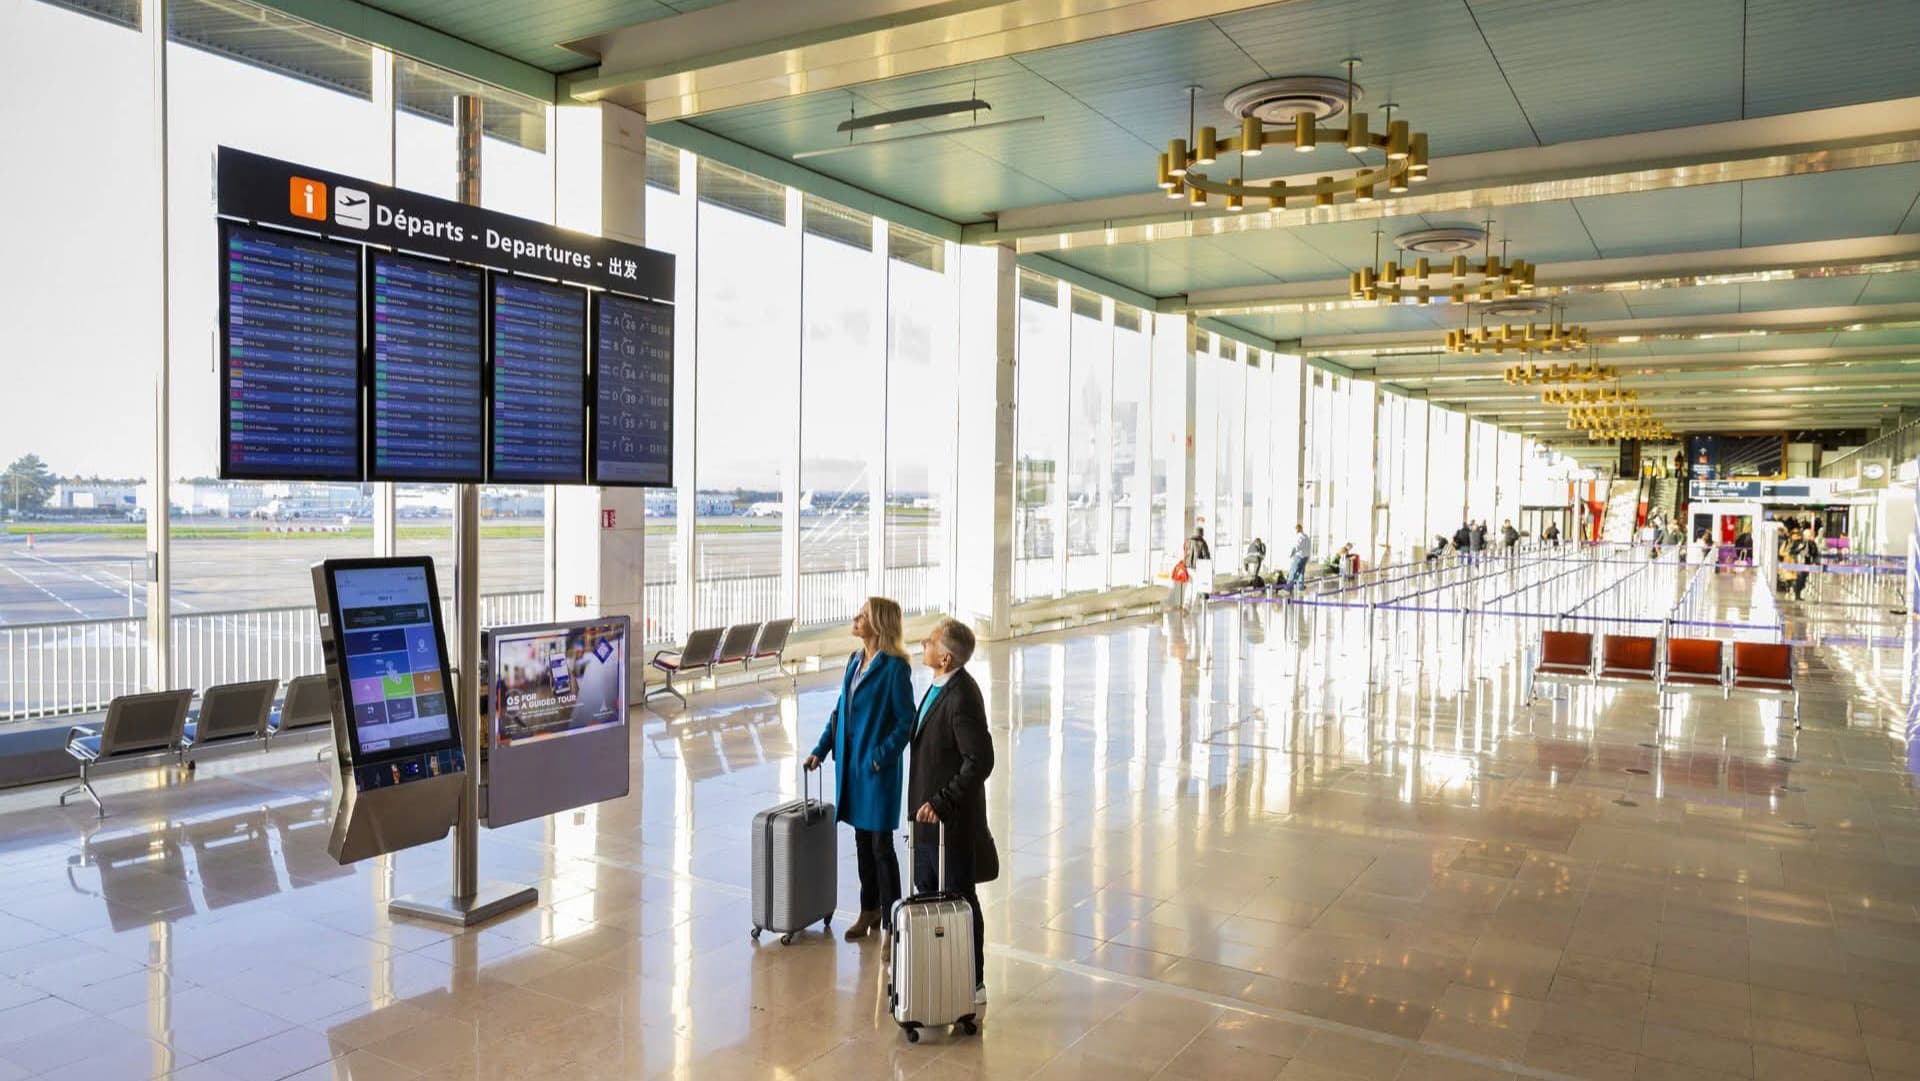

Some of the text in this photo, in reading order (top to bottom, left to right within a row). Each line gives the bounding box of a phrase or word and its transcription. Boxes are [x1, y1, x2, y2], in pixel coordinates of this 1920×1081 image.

[376, 204, 464, 242] Départs
[486, 228, 592, 269] Departures
[608, 256, 638, 280] 出发
[521, 693, 537, 702] FOR
[521, 702, 528, 710] A
[528, 697, 556, 709] GUIDED
[558, 694, 577, 704] TOUR
